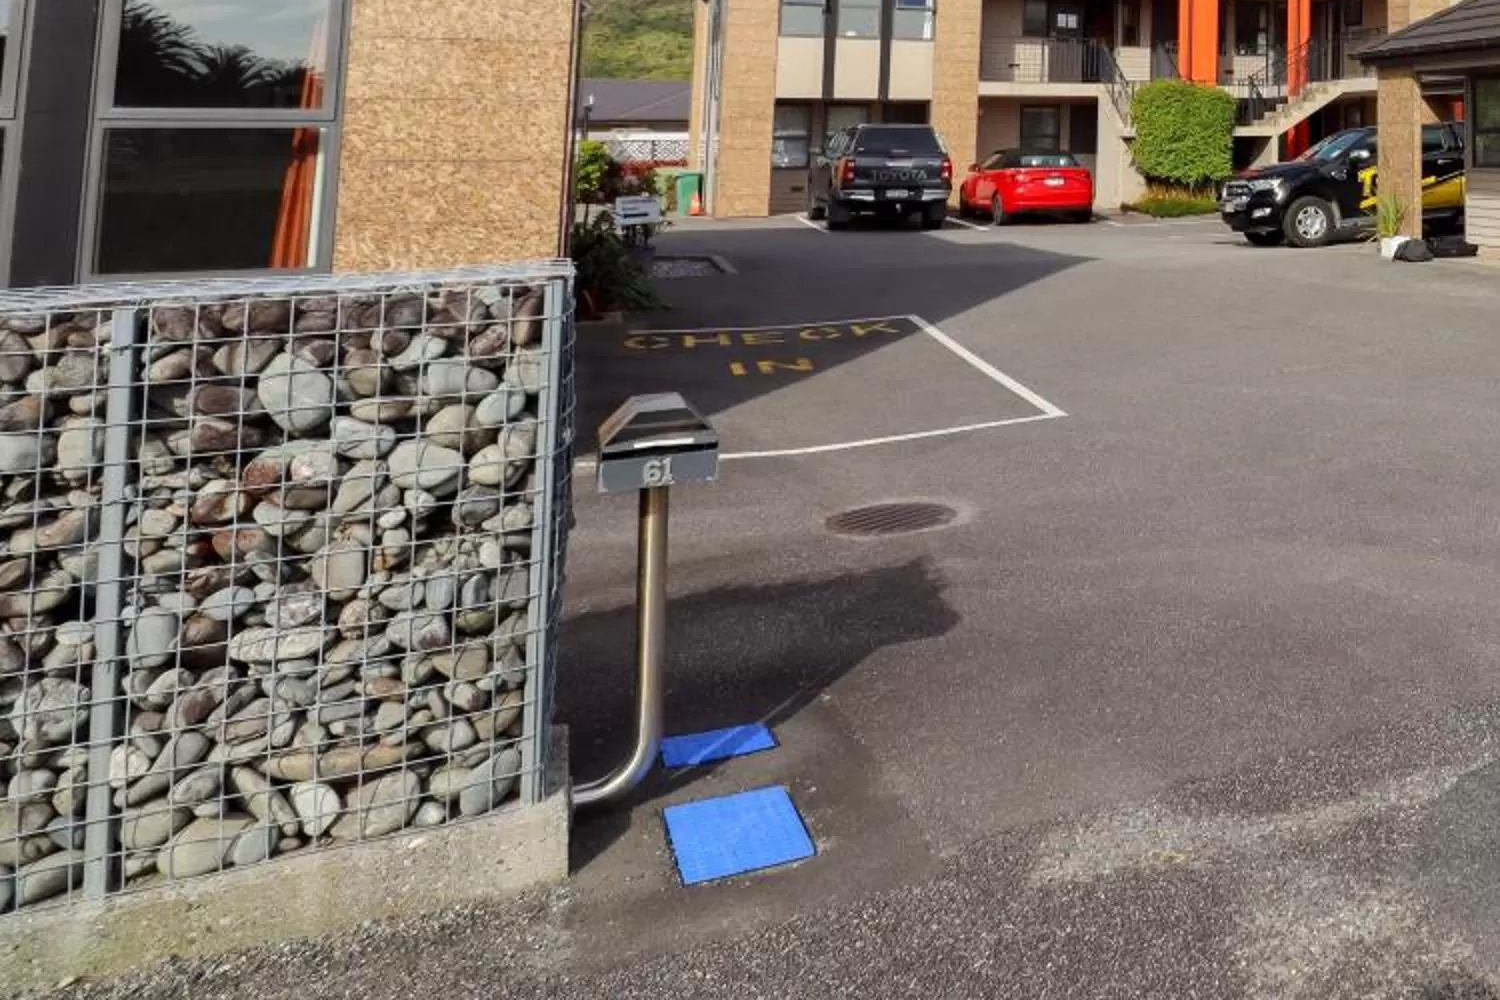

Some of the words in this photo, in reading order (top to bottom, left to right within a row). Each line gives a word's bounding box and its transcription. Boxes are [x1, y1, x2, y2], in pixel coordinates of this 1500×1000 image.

[872, 168, 928, 182] TOYOTA
[624, 322, 899, 349] CHECK
[729, 357, 815, 376] IN
[643, 457, 673, 486] 61
